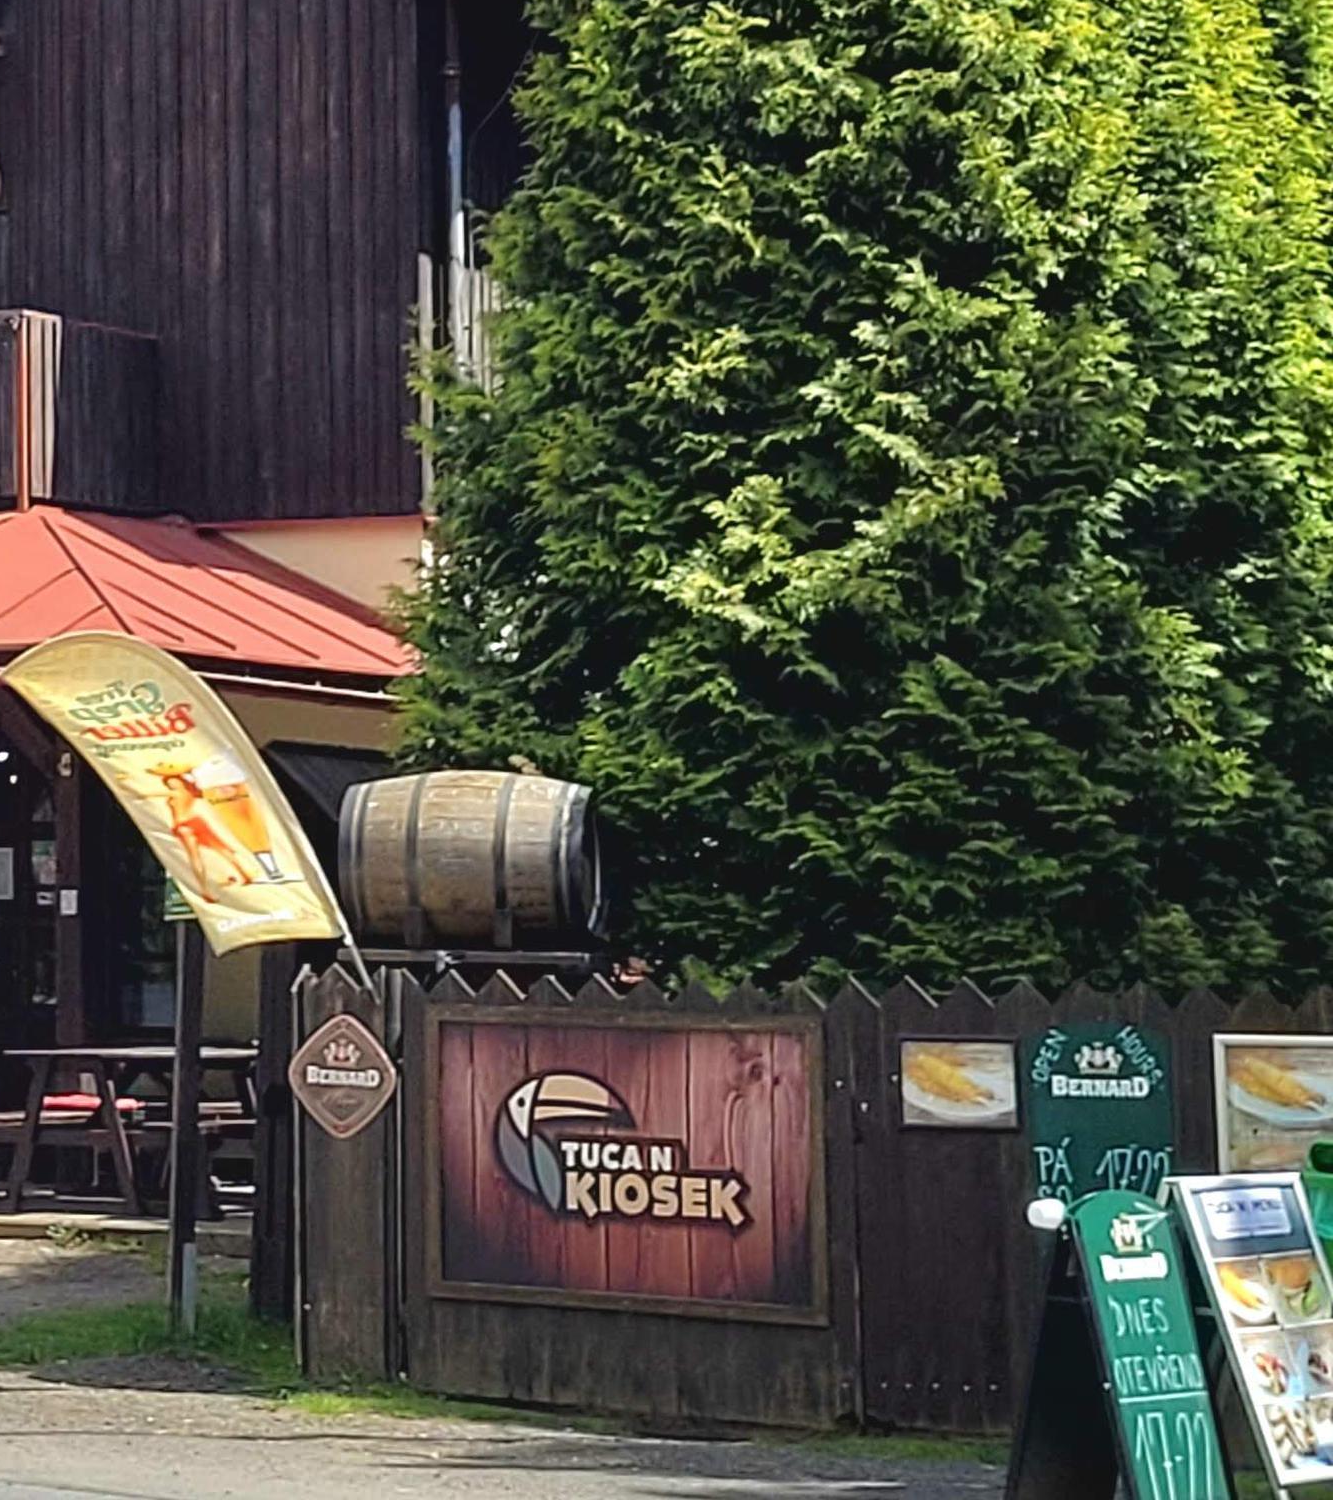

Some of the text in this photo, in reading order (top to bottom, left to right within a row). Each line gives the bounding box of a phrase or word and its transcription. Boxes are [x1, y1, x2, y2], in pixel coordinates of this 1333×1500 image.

[1031, 1028, 1068, 1083] OPEN
[1050, 1074, 1151, 1099] BERNARD
[1033, 1137, 1074, 1184] PÁ
[565, 1171, 745, 1227] KIOSEK
